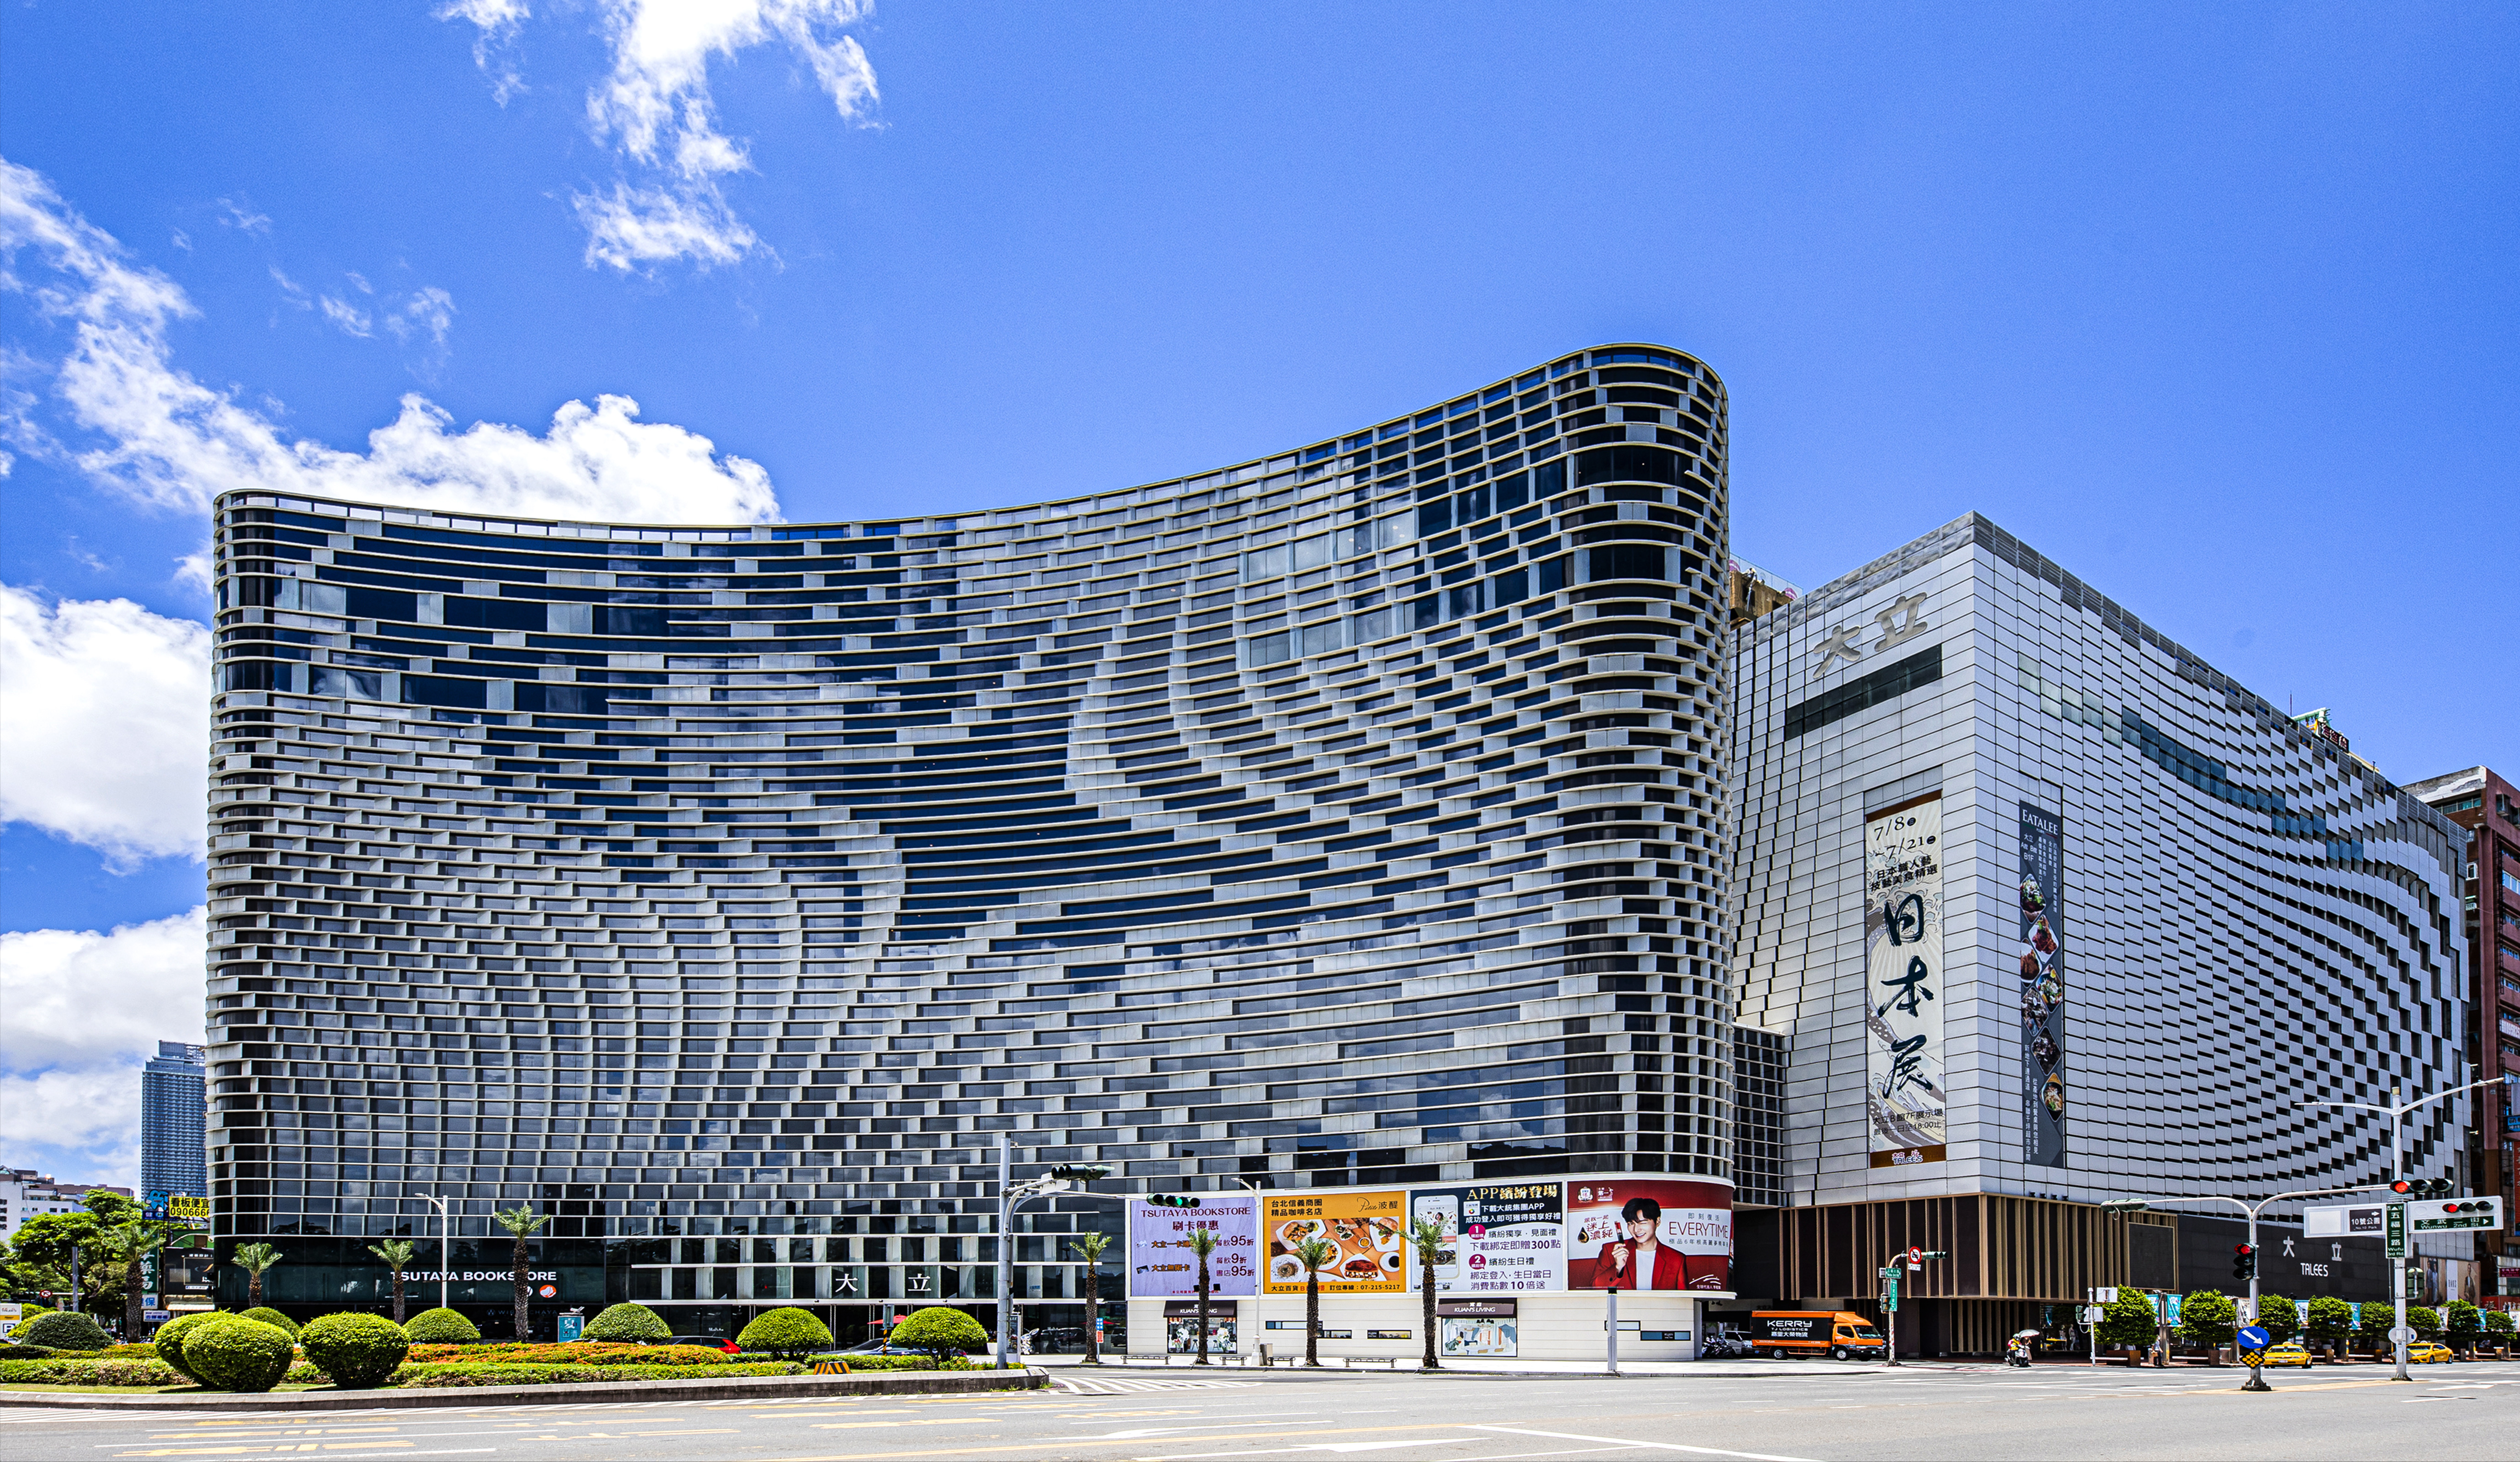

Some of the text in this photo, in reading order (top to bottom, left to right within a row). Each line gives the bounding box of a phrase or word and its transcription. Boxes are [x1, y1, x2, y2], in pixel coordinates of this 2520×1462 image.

[1813, 592, 1927, 678] 大立
[2022, 809, 2058, 835] EATALEE
[2023, 852, 2034, 862] B1F
[171, 1198, 209, 1208] 看板便宜
[1271, 1199, 1322, 1207] 台北信義商圈
[1141, 1207, 1250, 1217] TSUTAYA BOOKSTORE
[1271, 1208, 1322, 1217] 精品咖啡名店
[1172, 1220, 1219, 1231] 刷卡優惠
[2421, 1217, 2479, 1225] 文武二街
[1669, 1222, 1728, 1238] EVERYTIME
[2391, 1212, 2400, 1246] 五福三路
[2300, 1263, 2328, 1277] TALEES
[463, 1271, 556, 1281] BOOKSORE
